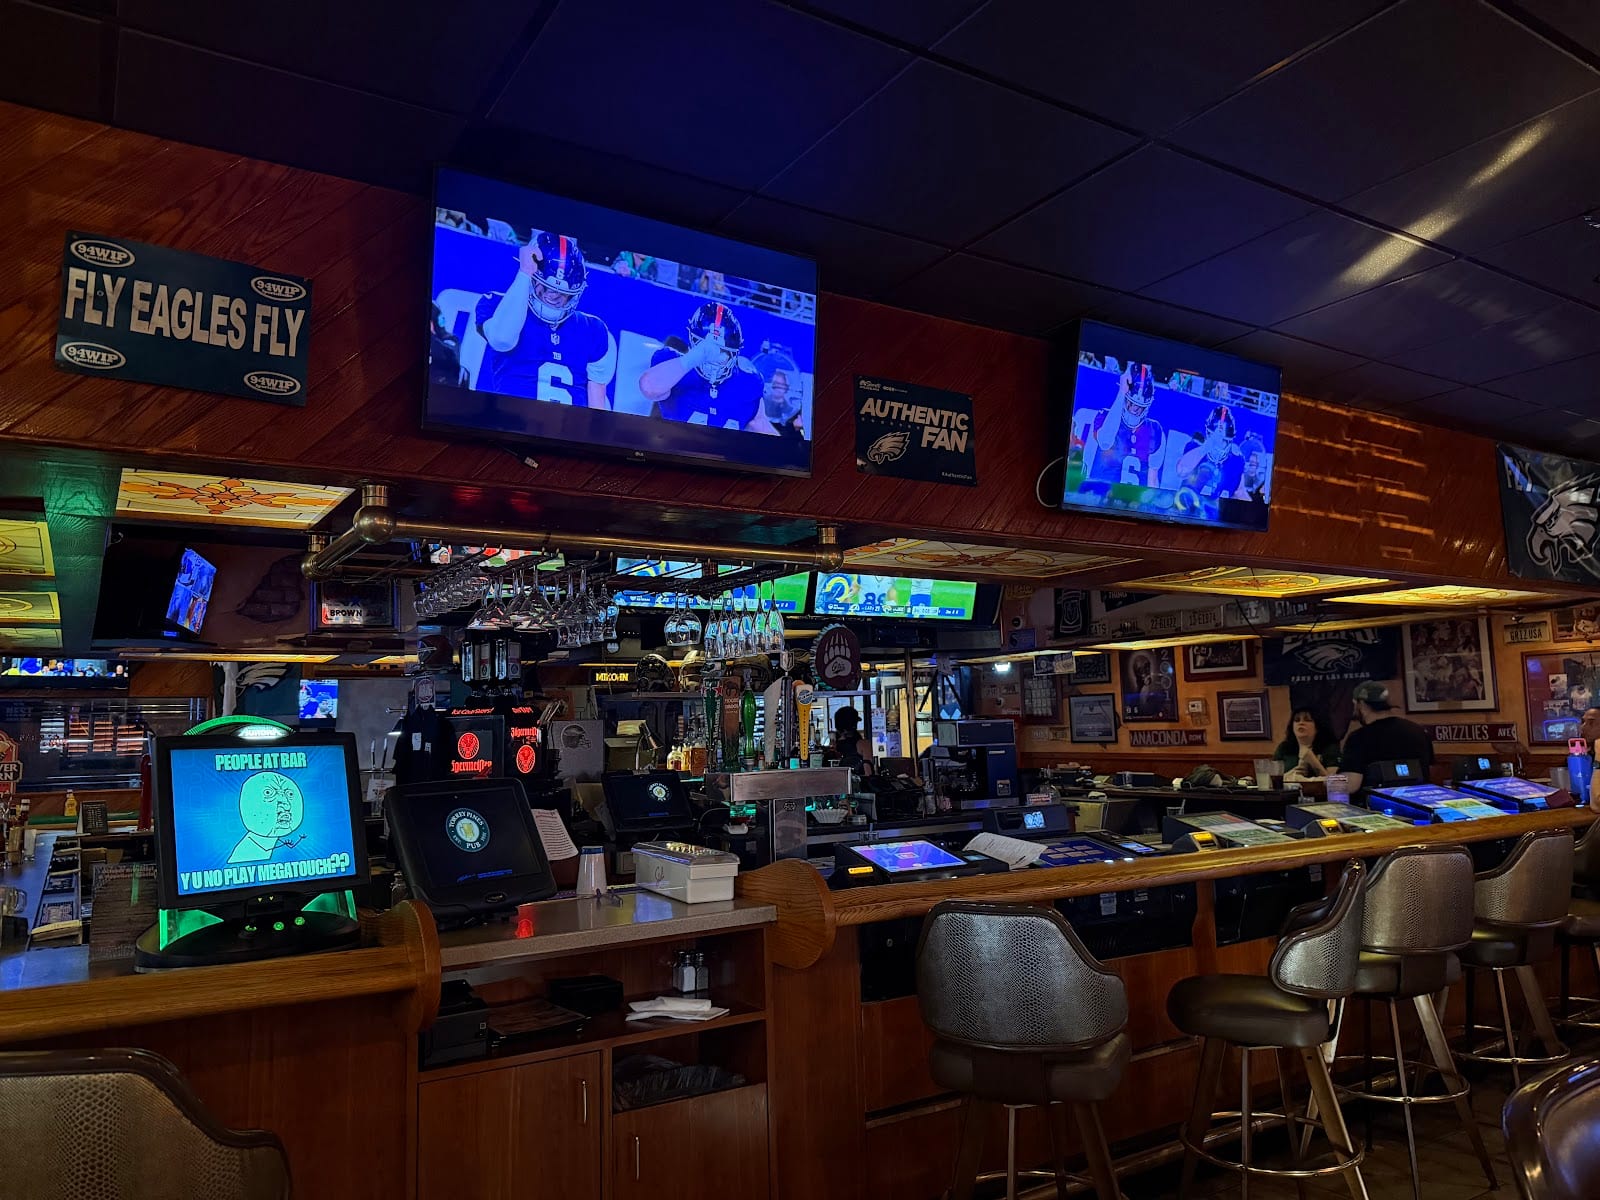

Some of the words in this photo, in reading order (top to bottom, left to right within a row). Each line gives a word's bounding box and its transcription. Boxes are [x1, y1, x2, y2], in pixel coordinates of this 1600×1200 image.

[77, 243, 129, 261] 94WIP
[256, 280, 300, 295] 94WIP
[64, 266, 127, 328] FLY
[129, 279, 248, 350] EAGLES
[252, 302, 306, 358] FLY
[67, 346, 119, 362] 94WIP
[249, 375, 294, 390] 94WIP
[537, 361, 573, 406] 6
[859, 397, 970, 431] AUTHENTIC
[920, 425, 969, 454] FAN
[1119, 455, 1141, 486] 6
[330, 609, 362, 617] BROWN
[1132, 730, 1188, 745] ANACONDA
[1435, 724, 1490, 740] GRIZZLIES
[1497, 728, 1512, 737] AVE
[215, 753, 262, 771] PEOPLE
[263, 752, 280, 769] AT
[280, 752, 307, 769] BAR
[449, 811, 466, 828] TORREY
[466, 811, 484, 826] PINES
[466, 841, 481, 849] PUB
[181, 872, 191, 891] Y
[191, 871, 203, 890] U
[203, 869, 223, 888] NO
[223, 865, 256, 886] PLAY
[257, 852, 350, 882] MEGATOUCH??
